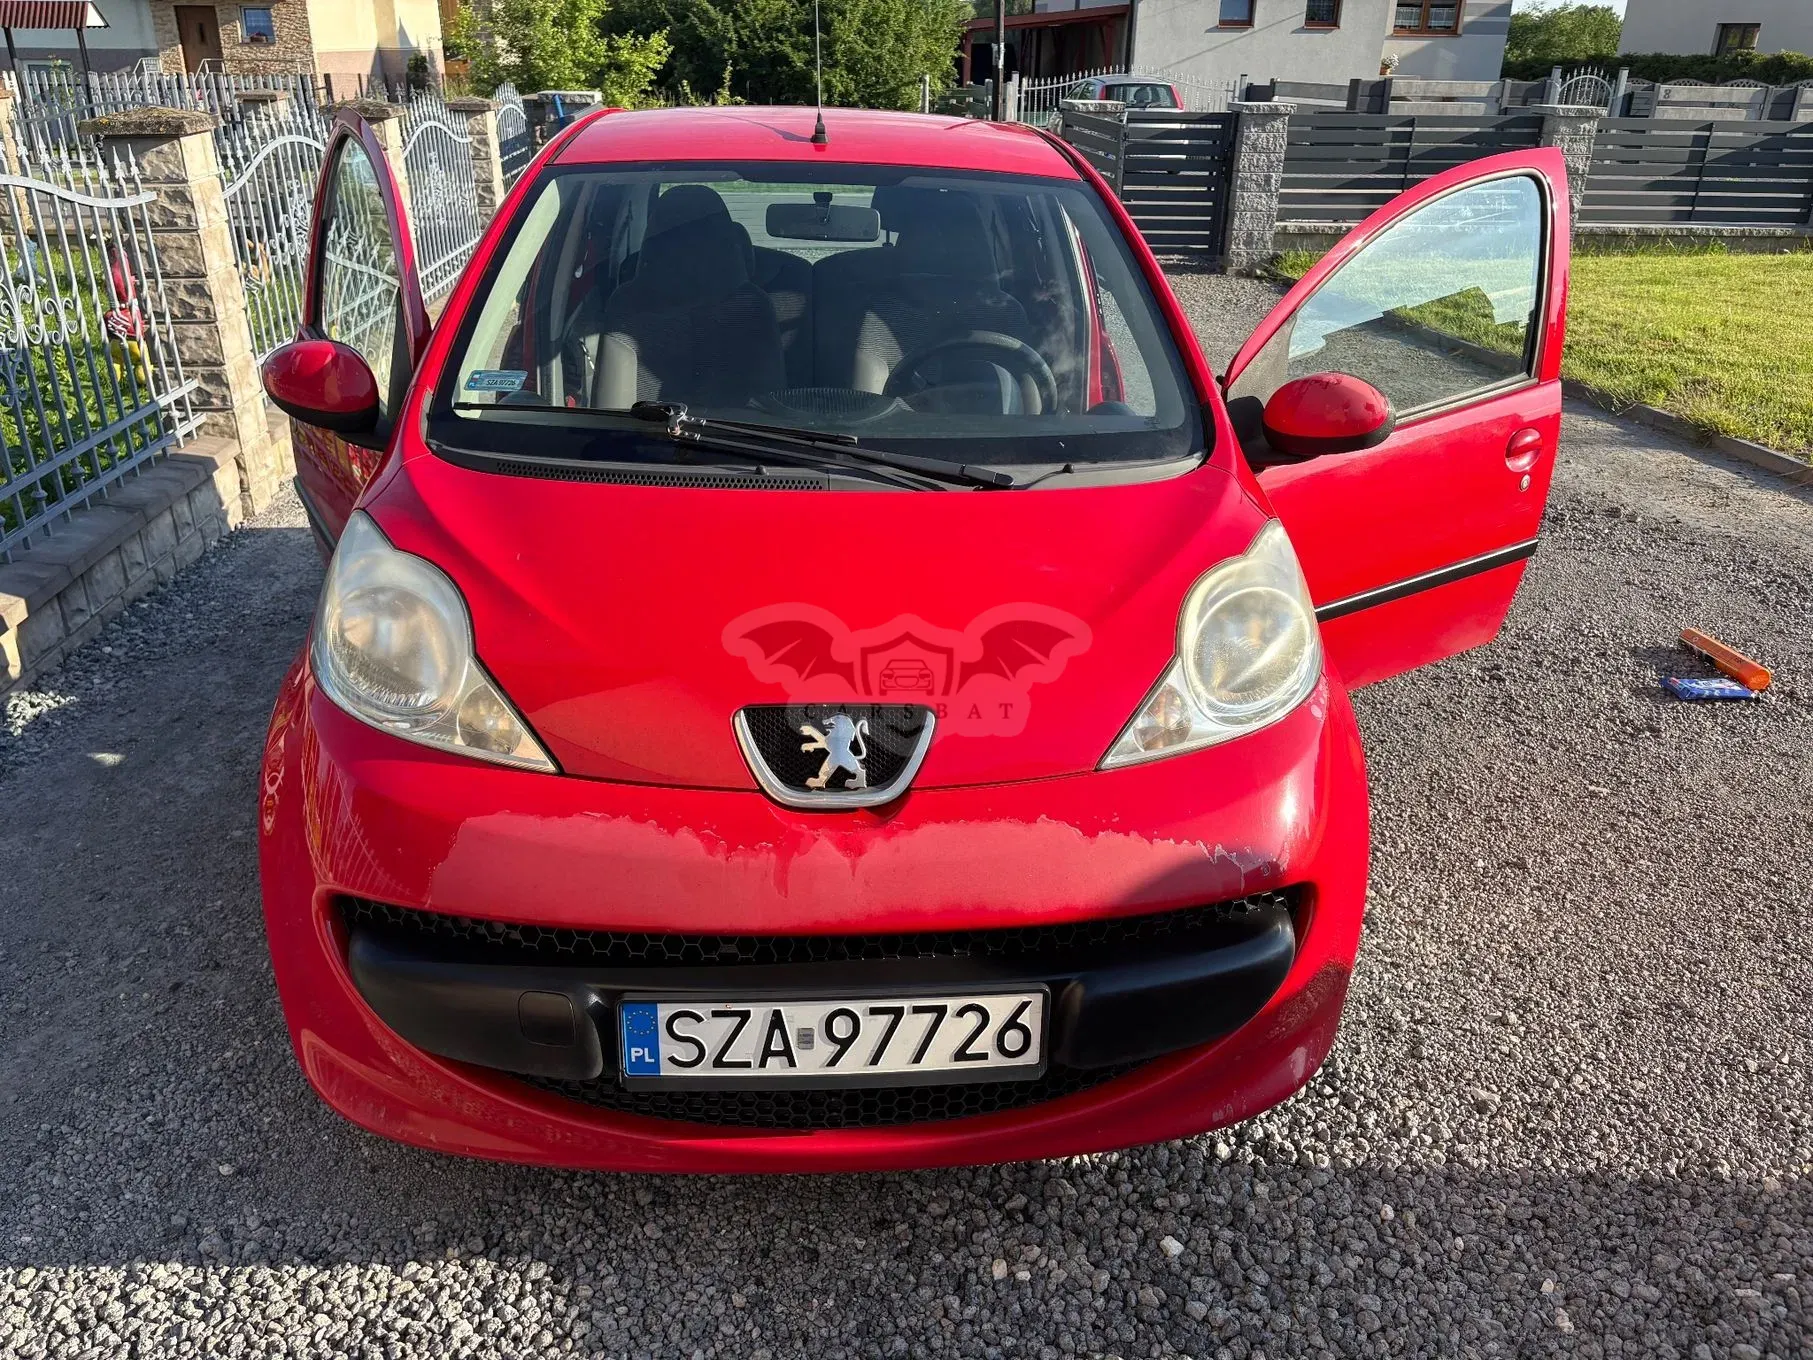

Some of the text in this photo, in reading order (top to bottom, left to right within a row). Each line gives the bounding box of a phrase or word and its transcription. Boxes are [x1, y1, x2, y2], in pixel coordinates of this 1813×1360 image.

[1663, 89, 1672, 99] 8
[665, 1000, 1032, 1068] SZA 97726
[630, 1048, 655, 1063] PL
